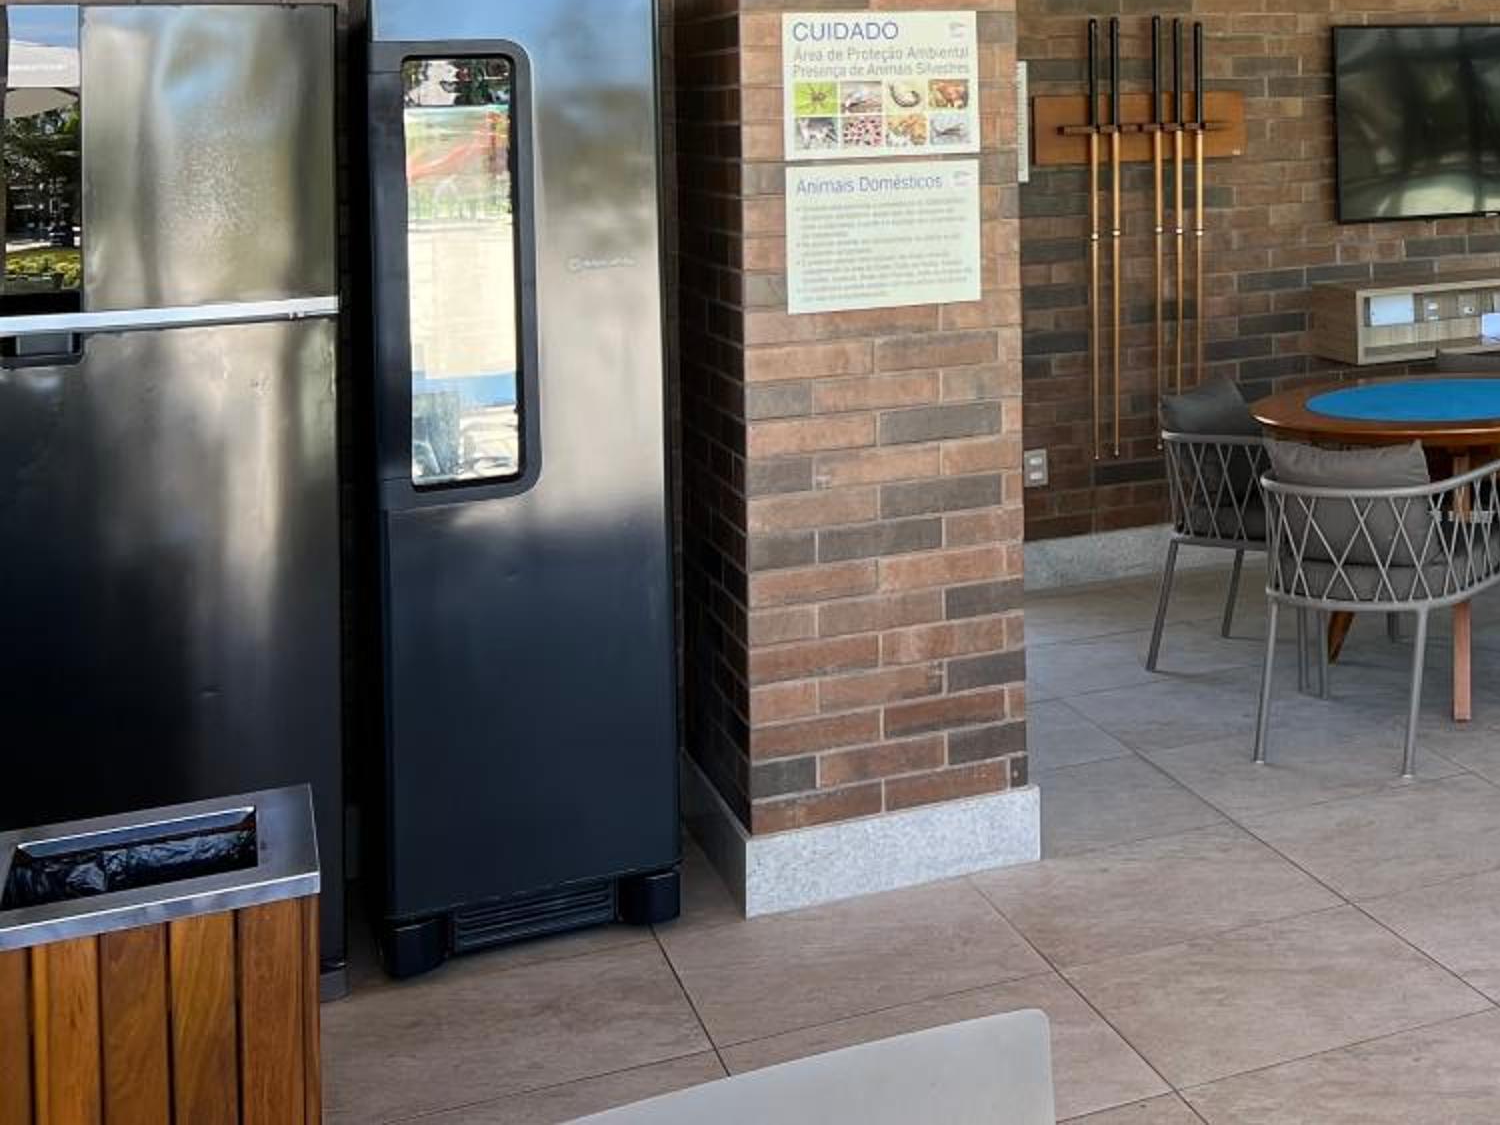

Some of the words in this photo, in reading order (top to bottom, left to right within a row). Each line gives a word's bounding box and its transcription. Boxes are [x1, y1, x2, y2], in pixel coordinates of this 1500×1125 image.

[792, 21, 899, 42] CUIDADO
[827, 47, 843, 61] de
[847, 46, 903, 63] Proteção
[907, 44, 969, 61] Ambiental
[793, 63, 847, 78] Presença
[849, 62, 865, 76] de
[867, 62, 914, 76] Animais
[796, 180, 855, 196] Animais
[859, 175, 943, 193] Domésticos
